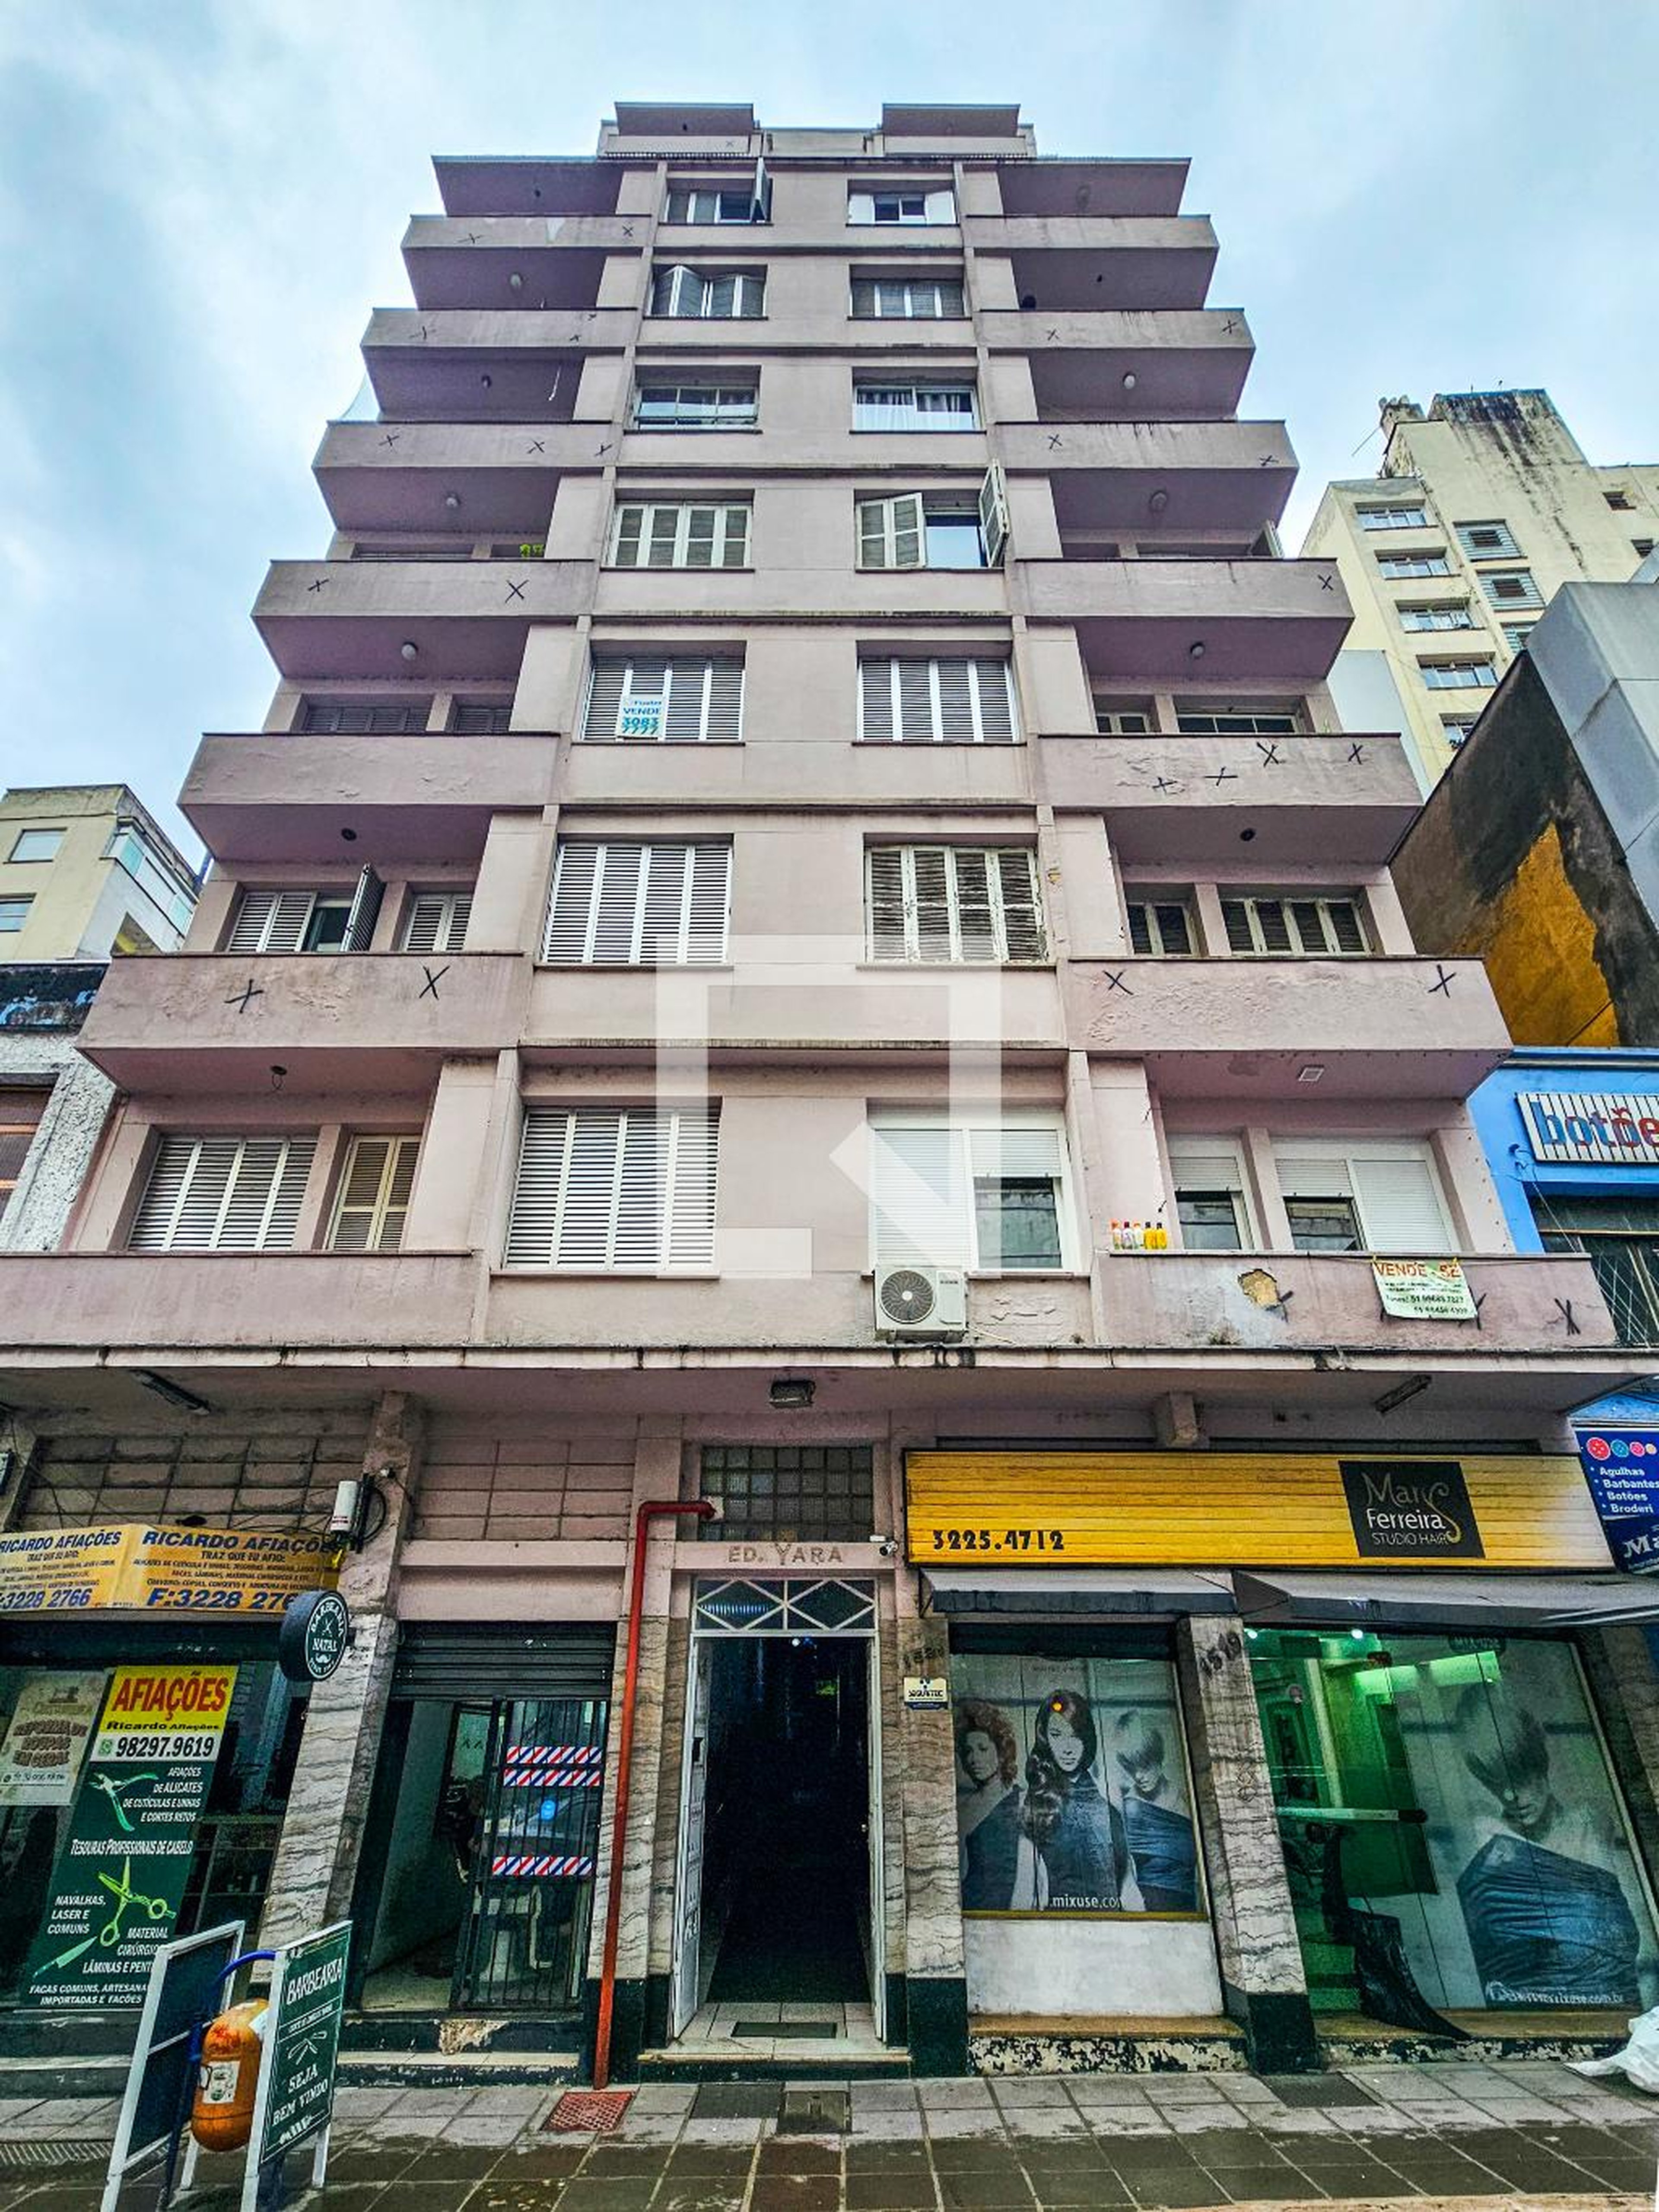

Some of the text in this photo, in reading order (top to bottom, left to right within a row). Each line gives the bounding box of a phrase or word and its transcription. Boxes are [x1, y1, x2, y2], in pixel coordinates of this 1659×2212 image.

[1367, 1508, 1446, 1529] Ferreira
[0, 1529, 122, 1553] RICARDO AFIAÇÕES
[142, 1531, 239, 1549] RICARDO
[933, 1530, 1064, 1550] 3225.4712
[775, 1542, 843, 1566] YARA
[47, 1588, 93, 1608] 2766
[147, 1588, 299, 1609] F:3228 276
[111, 1671, 229, 1721] AFIAÇÕES
[106, 1720, 167, 1730] Ricardo
[116, 1736, 214, 1757] 98297.9619
[164, 1782, 203, 1793] ALICATES
[54, 1895, 106, 1906] NAVALHAS,
[51, 1909, 91, 1920] LASER E
[47, 1924, 90, 1934] COMUNS
[127, 1927, 168, 1939] MATERIAL
[116, 1941, 158, 1956] CIRÚRGIC
[82, 1959, 152, 1974] LÂMINAS E PENT
[59, 1984, 100, 1994] COMUNS,
[102, 1983, 147, 1993] ARTESANA
[286, 1957, 342, 2005] BARBEARIA
[40, 1995, 98, 2005] IMPORTADAS
[272, 2099, 297, 2127] BEM
